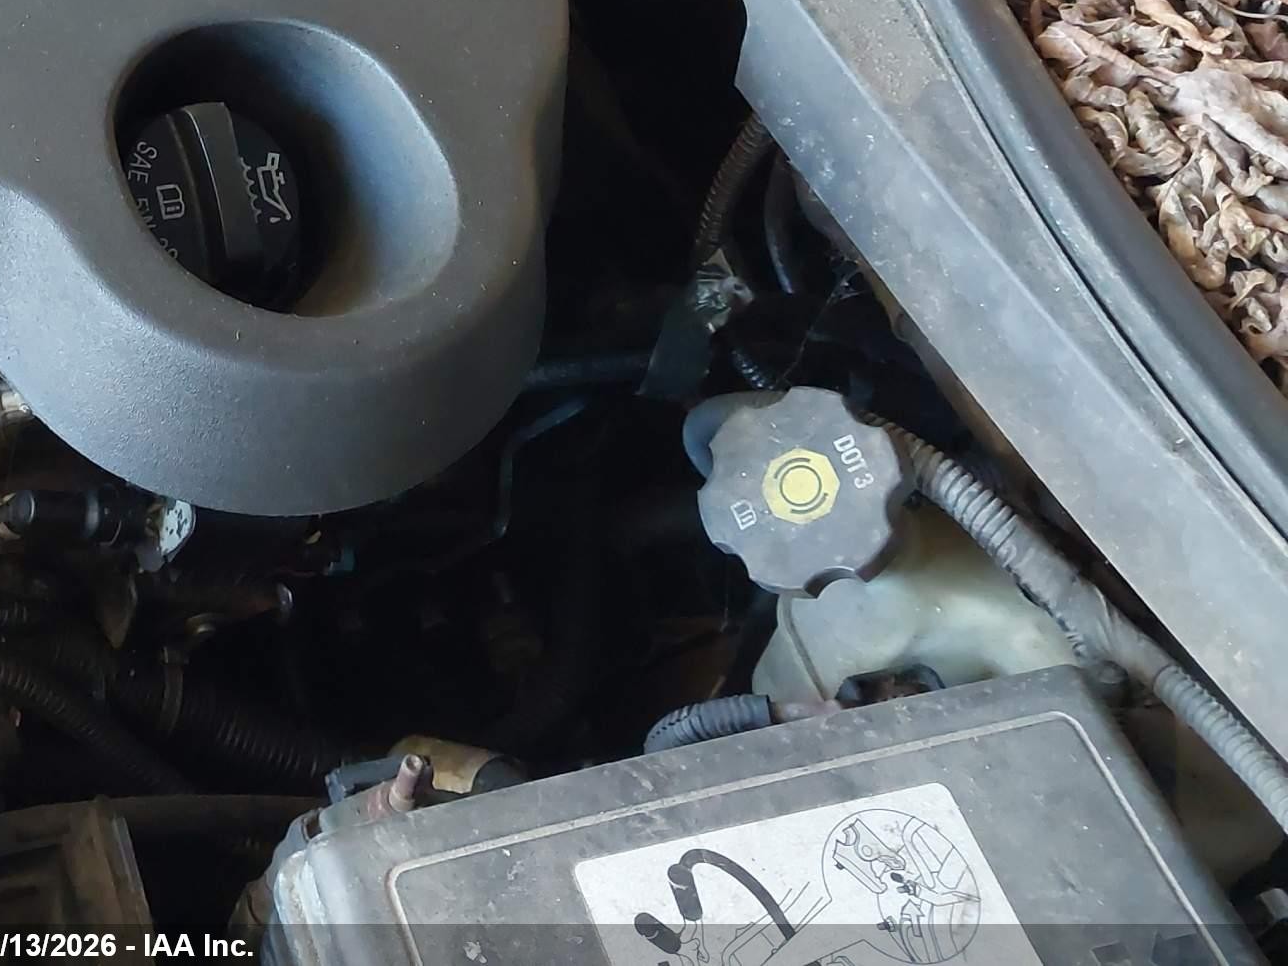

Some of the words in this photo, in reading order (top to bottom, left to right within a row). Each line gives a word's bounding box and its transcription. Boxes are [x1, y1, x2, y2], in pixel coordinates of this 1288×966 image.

[127, 140, 159, 185] SAE
[832, 434, 868, 474] DOT
[853, 472, 875, 490] 3
